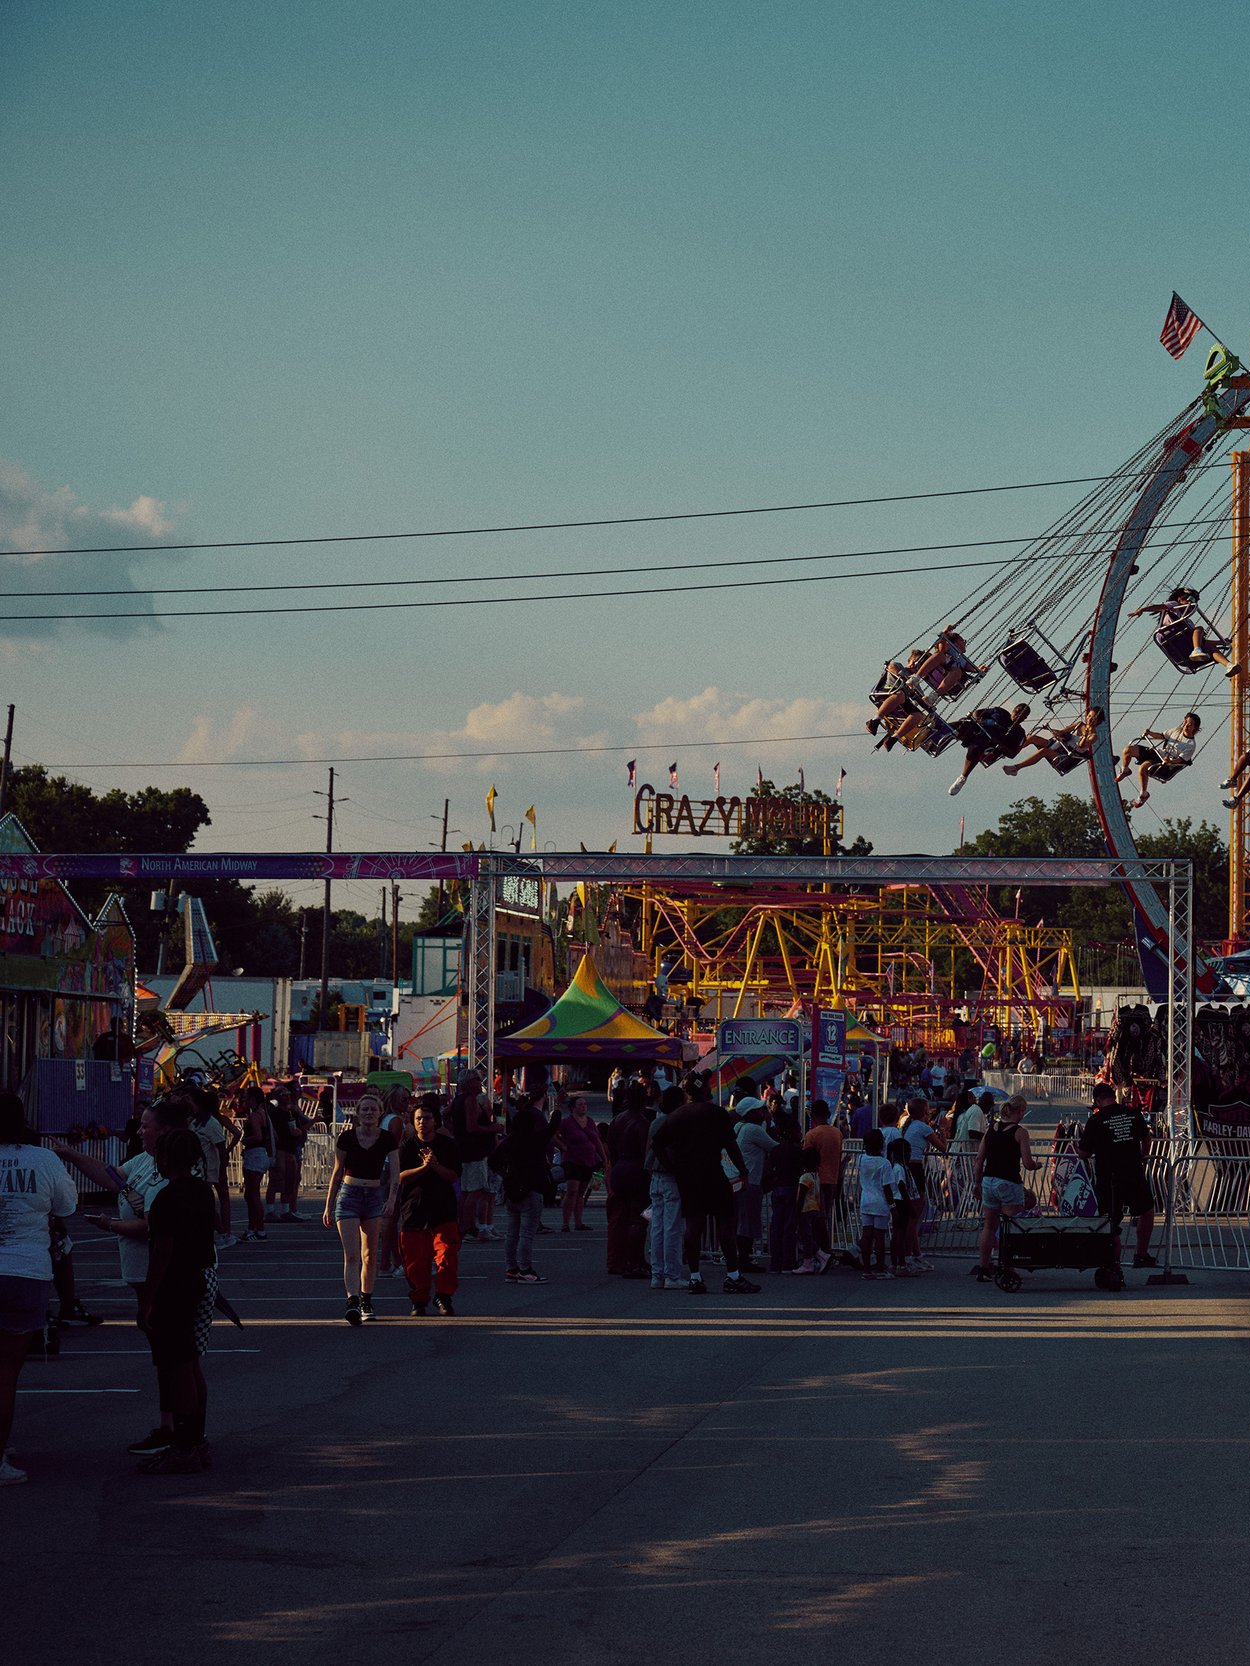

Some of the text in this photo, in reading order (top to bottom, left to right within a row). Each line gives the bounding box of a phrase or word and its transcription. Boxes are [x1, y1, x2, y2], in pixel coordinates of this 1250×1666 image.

[636, 783, 740, 836] CRAZY
[141, 857, 258, 871] NORTH AMERICAN MIDWAY
[725, 1029, 796, 1045] ENTRANCE
[827, 1024, 837, 1041] 12
[0, 1159, 19, 1168] ERO
